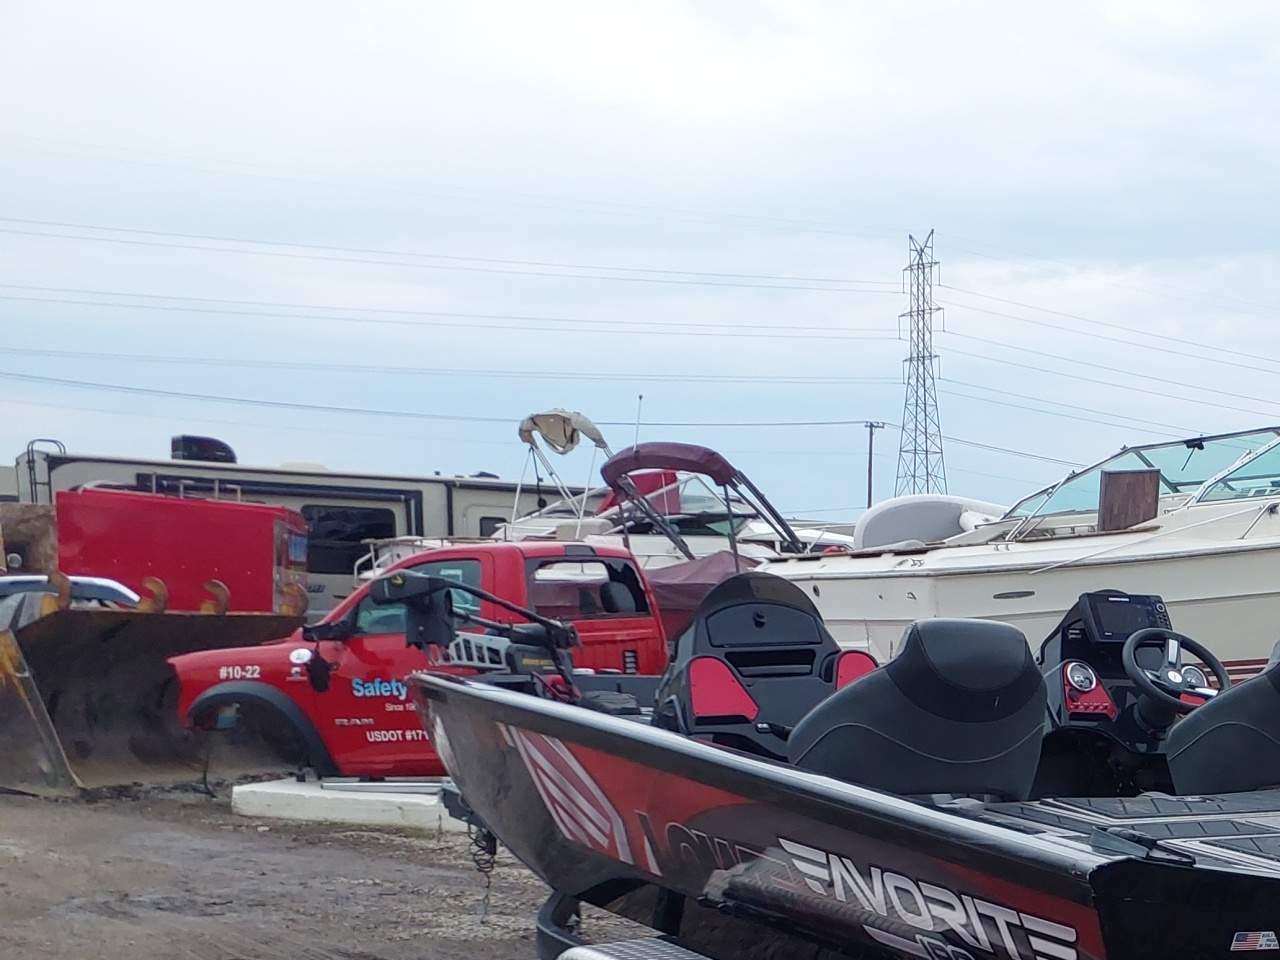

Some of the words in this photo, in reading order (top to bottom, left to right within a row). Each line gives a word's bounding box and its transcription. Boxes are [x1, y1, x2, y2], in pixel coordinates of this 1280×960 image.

[219, 666, 261, 679] #10-22
[351, 678, 408, 700] Safety
[366, 730, 403, 742] USDOT
